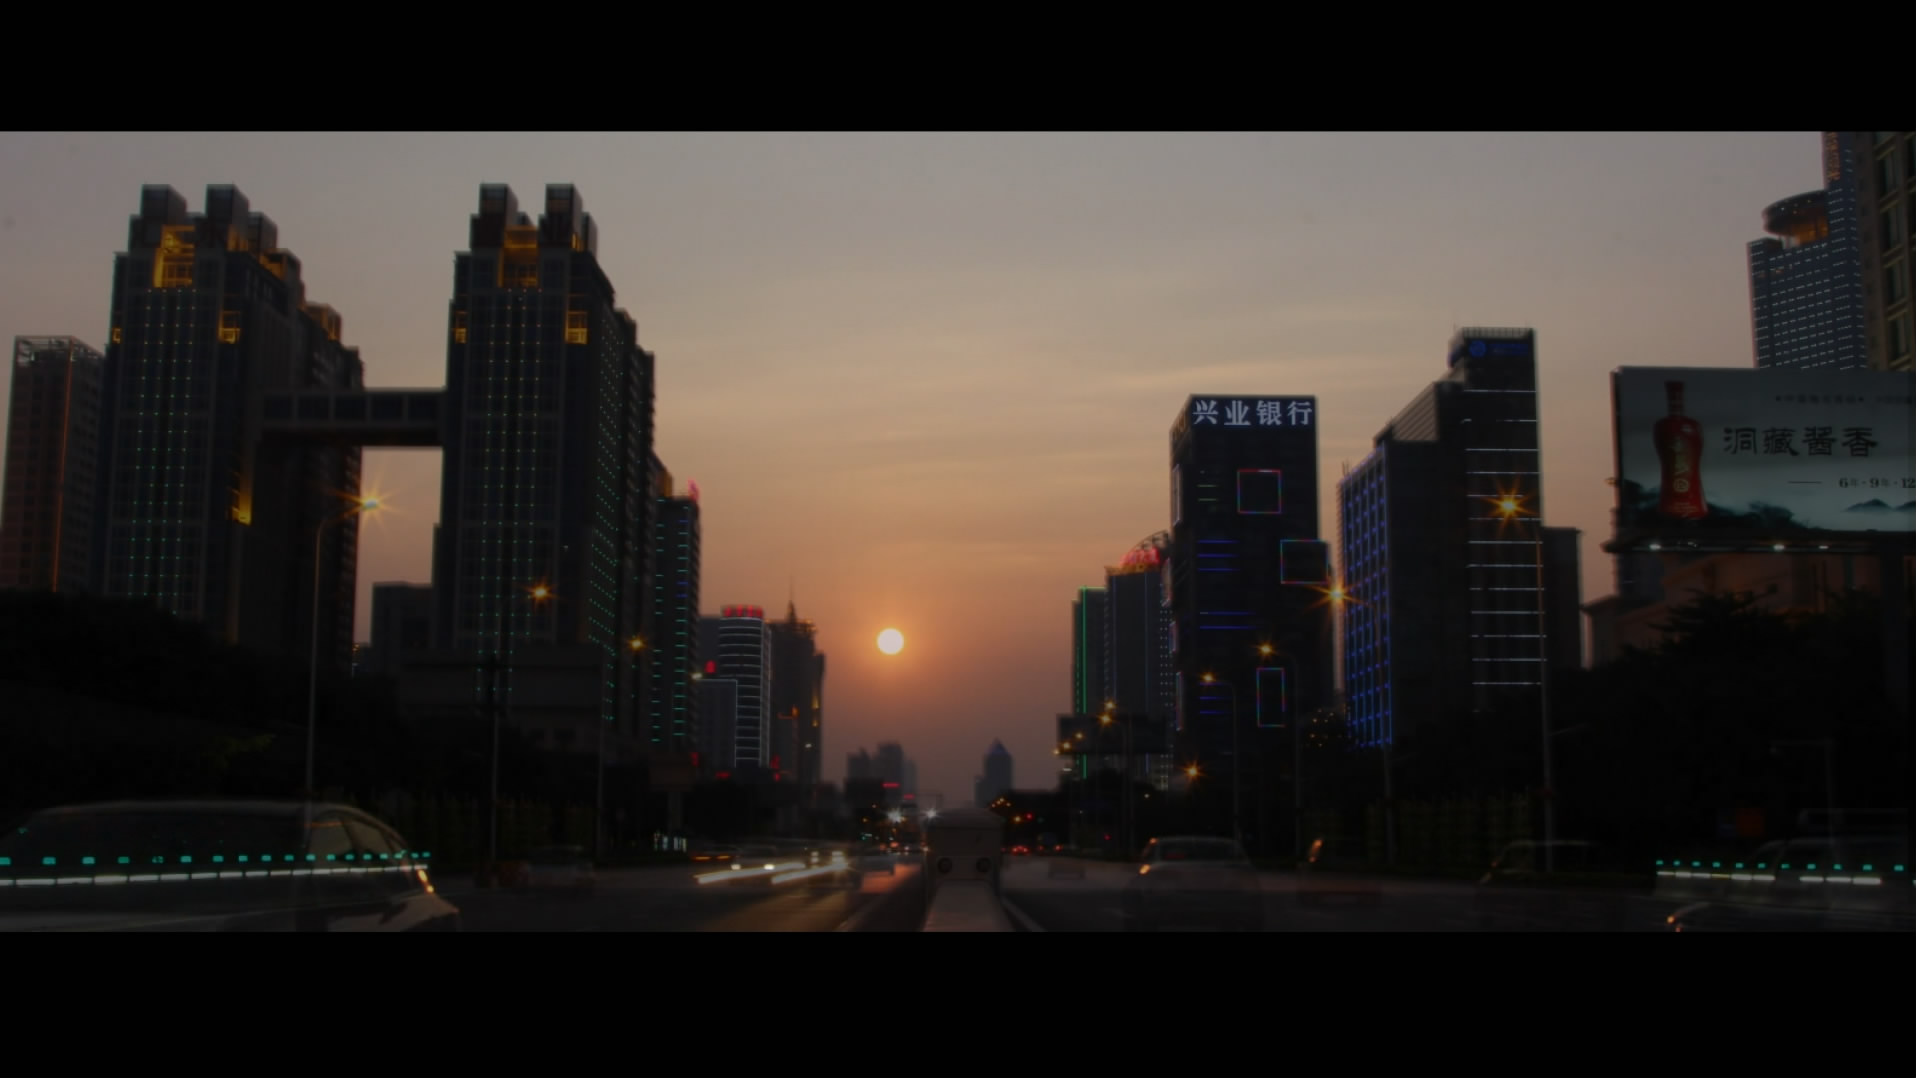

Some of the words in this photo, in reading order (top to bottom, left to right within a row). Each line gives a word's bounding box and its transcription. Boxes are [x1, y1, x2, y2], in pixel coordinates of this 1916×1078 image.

[1192, 399, 1313, 426] 兴业银行
[1723, 426, 1878, 457] 洞藏酱香
